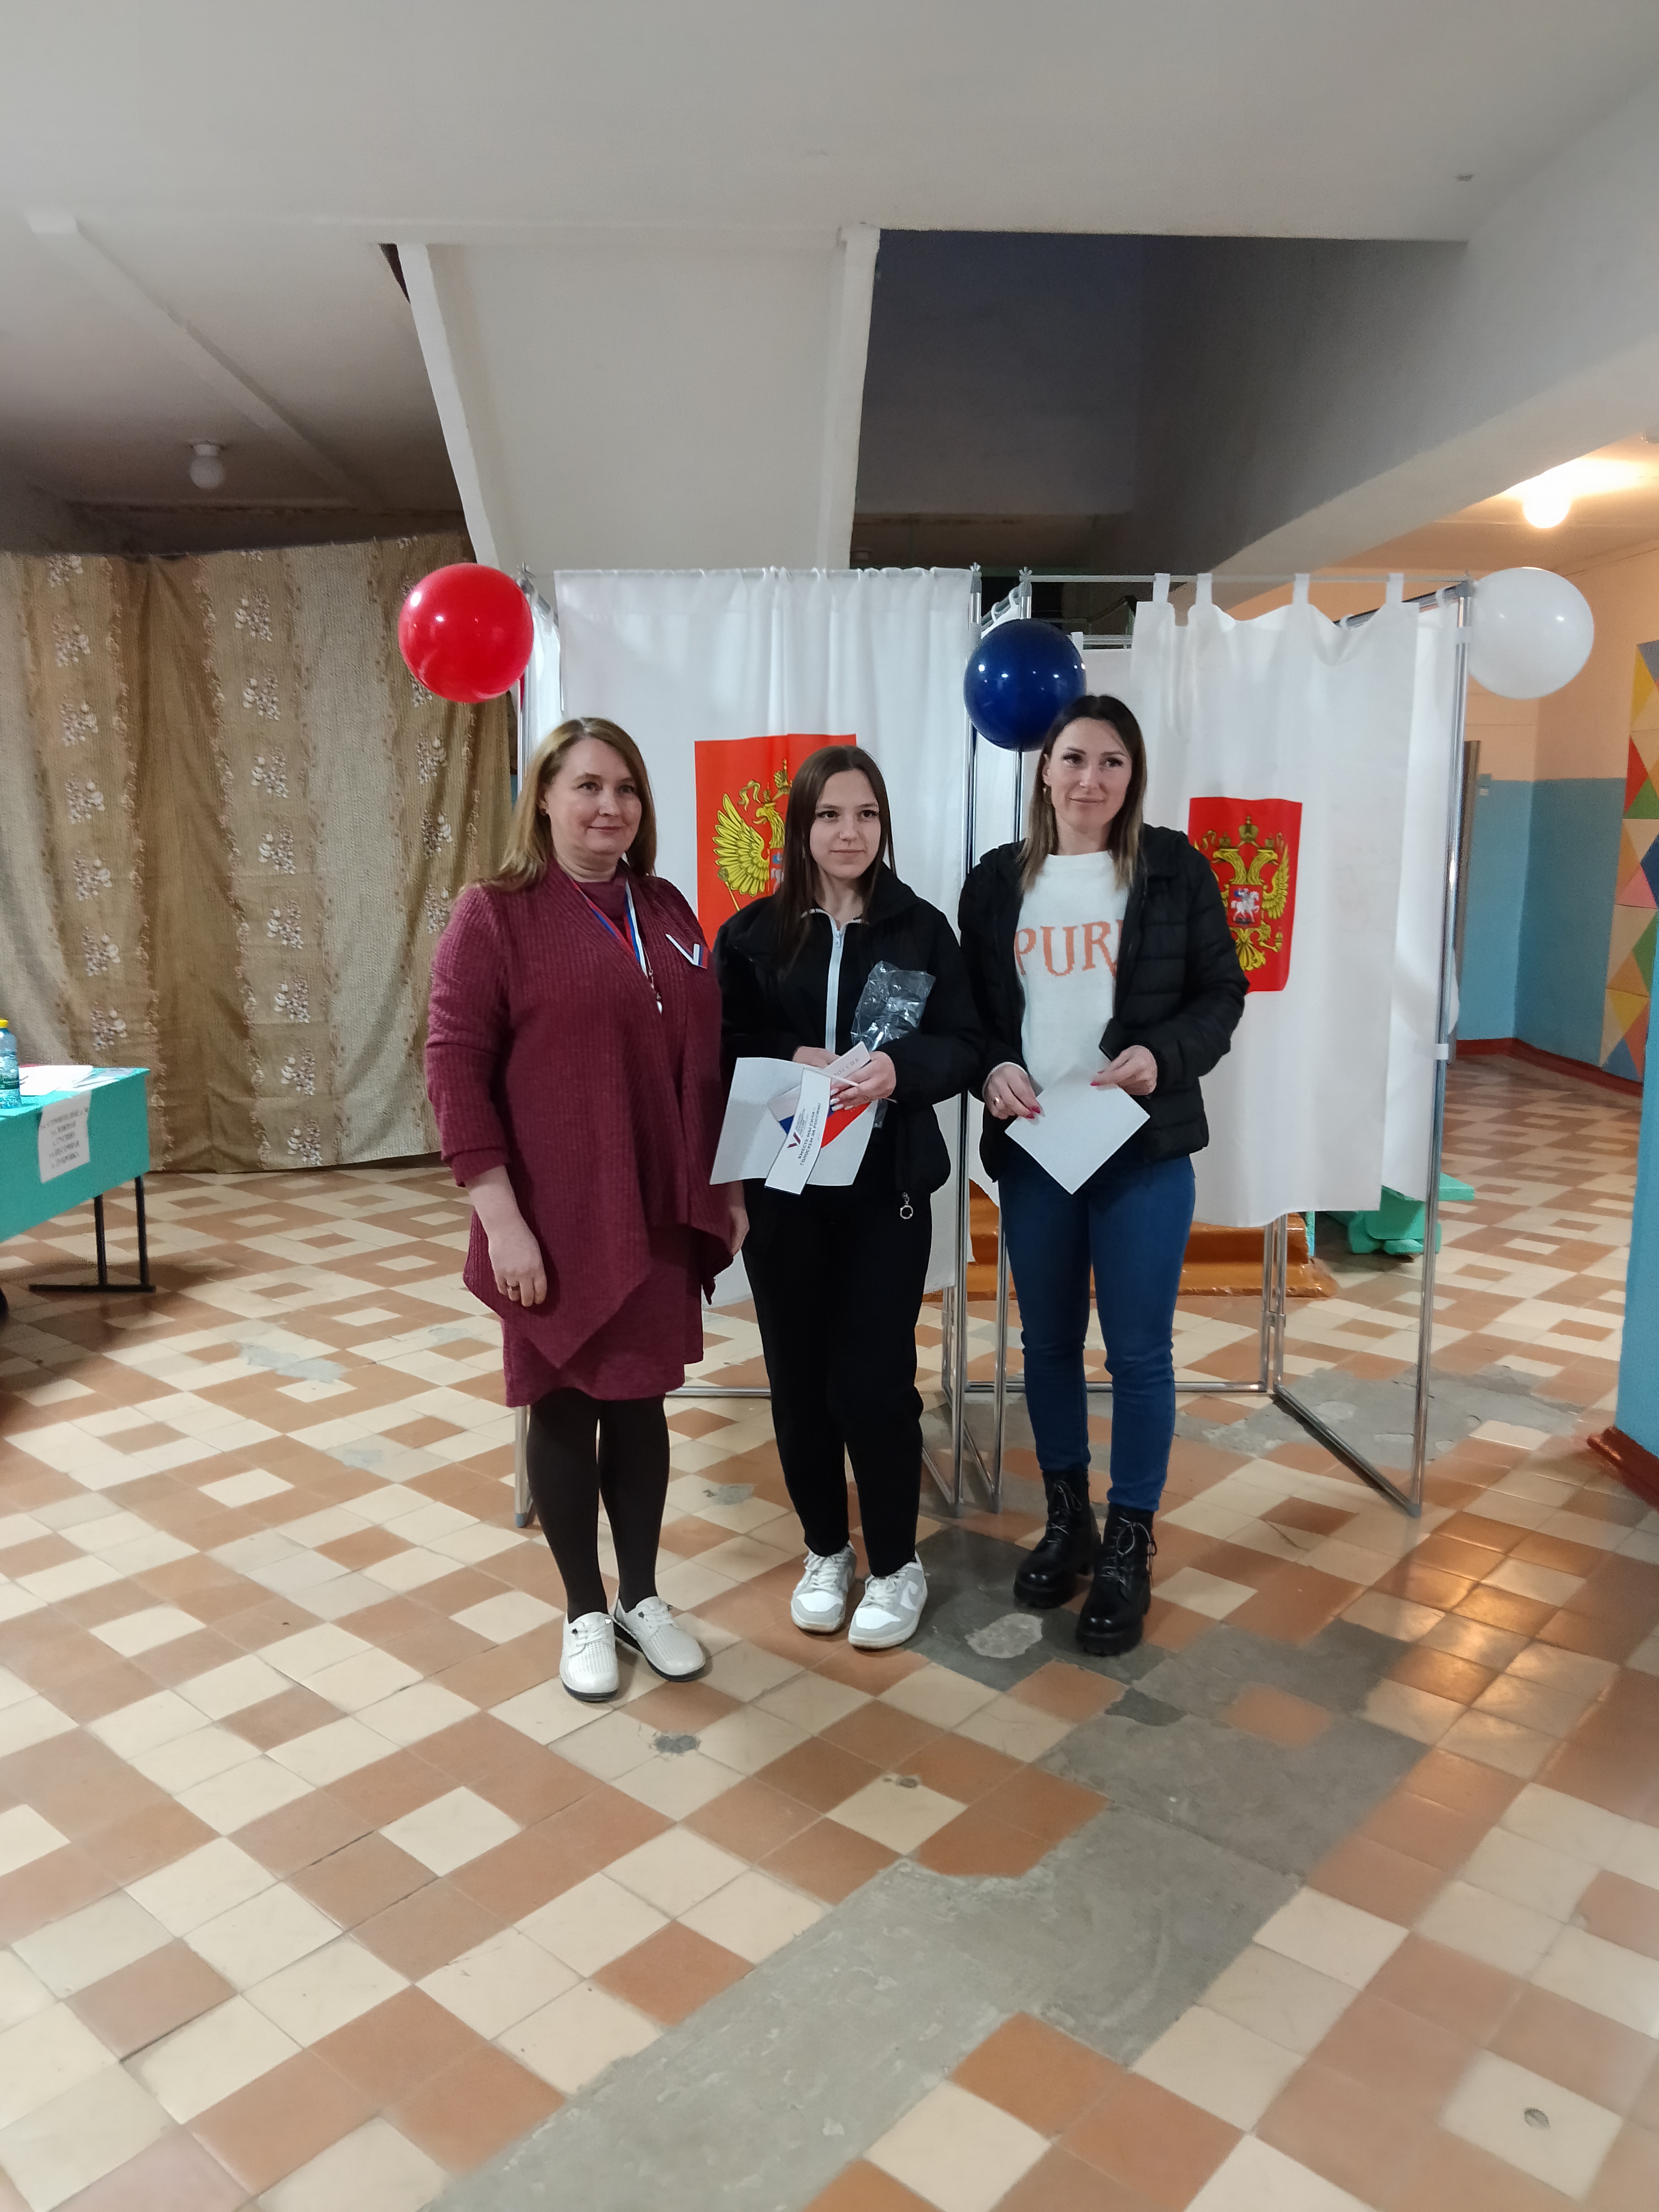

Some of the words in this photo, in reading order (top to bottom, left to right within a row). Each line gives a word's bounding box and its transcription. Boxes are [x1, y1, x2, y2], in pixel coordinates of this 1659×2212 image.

[798, 1138, 808, 1159] ВМЕСТЕ
[806, 1128, 812, 1138] МЫ
[800, 1137, 813, 1165] ГОЛОСУЕМ
[811, 1130, 816, 1138] ЗА
